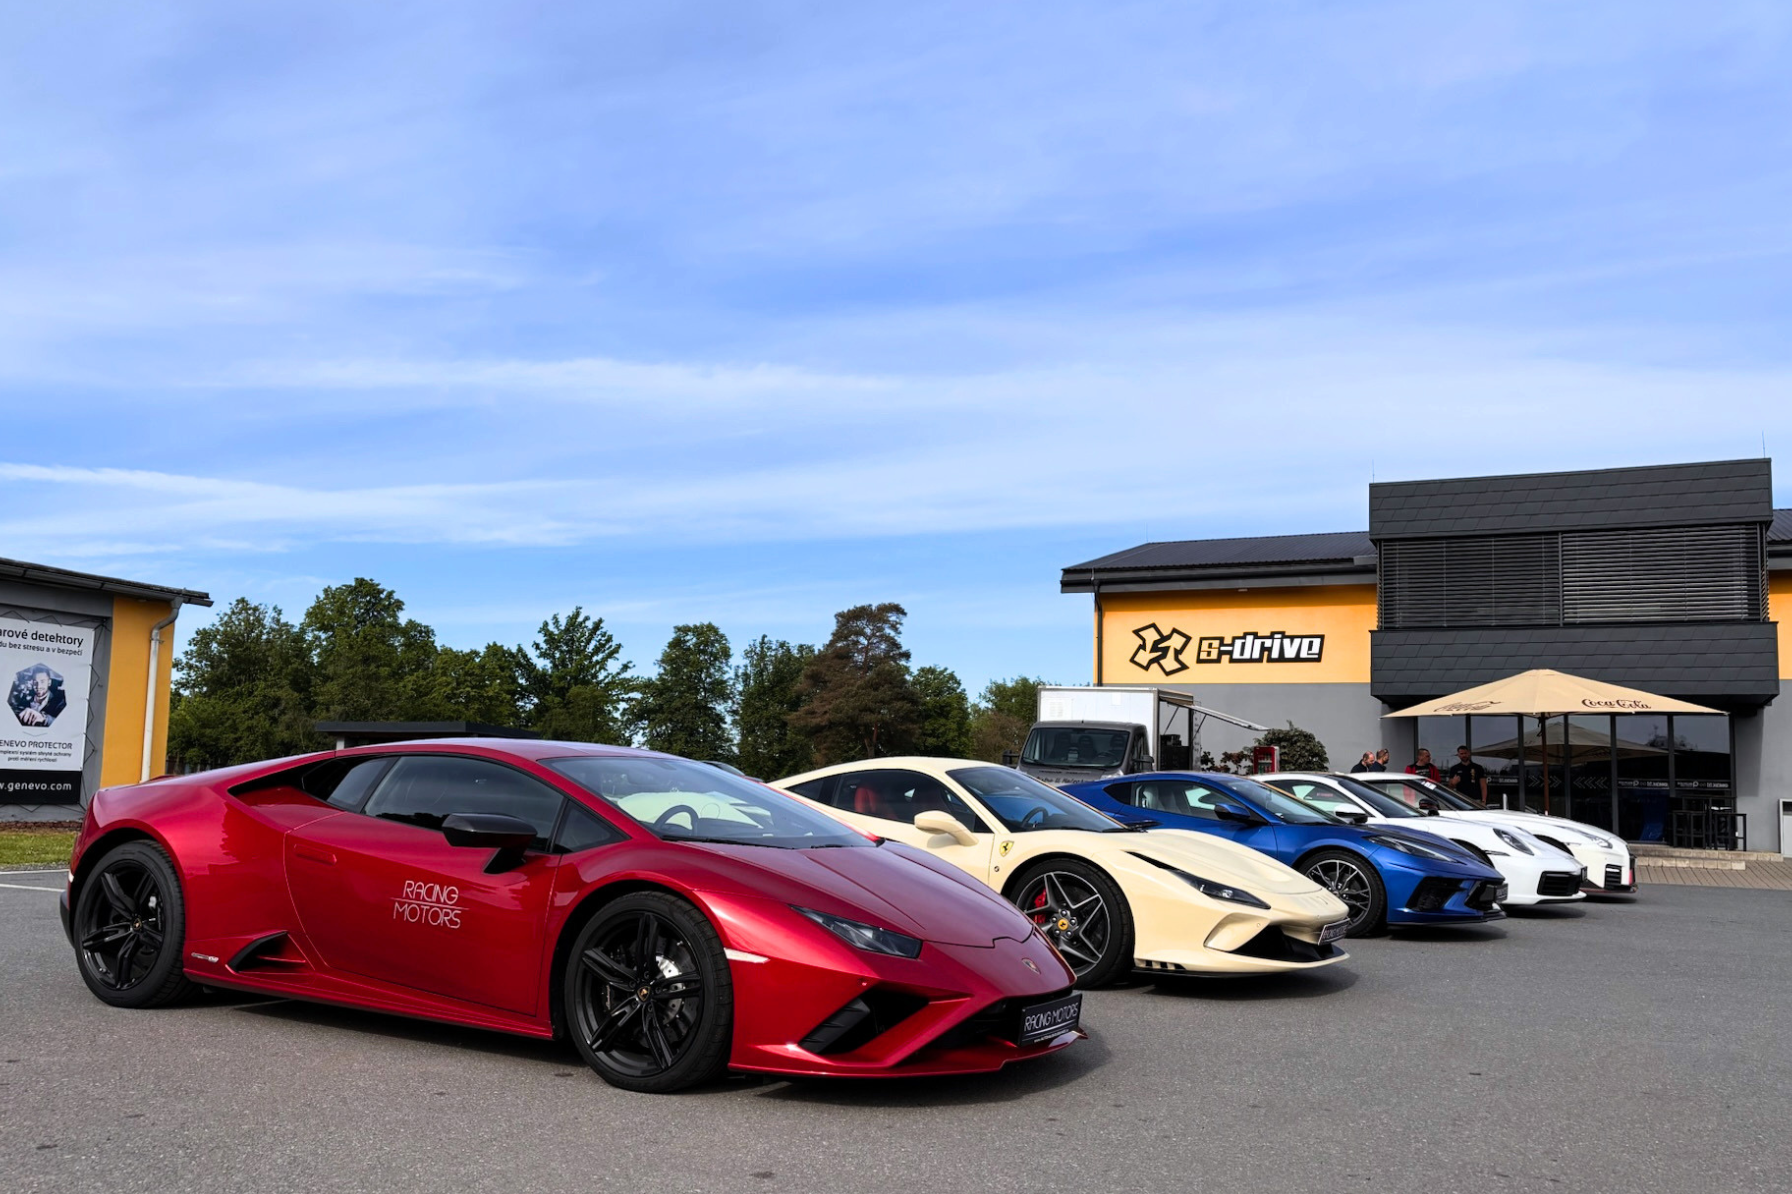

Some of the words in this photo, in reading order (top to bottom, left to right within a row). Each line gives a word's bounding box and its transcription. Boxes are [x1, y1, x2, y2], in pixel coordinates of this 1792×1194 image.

[8, 642, 22, 650] bez
[23, 644, 45, 652] stresu
[31, 631, 84, 648] detektory
[1198, 632, 1323, 662] s-drive
[28, 741, 73, 749] PROTECTOR
[403, 880, 459, 904] RACING
[393, 902, 462, 929] MOTORS
[1024, 1011, 1051, 1031] RACING
[1052, 1002, 1079, 1023] MOTORS
